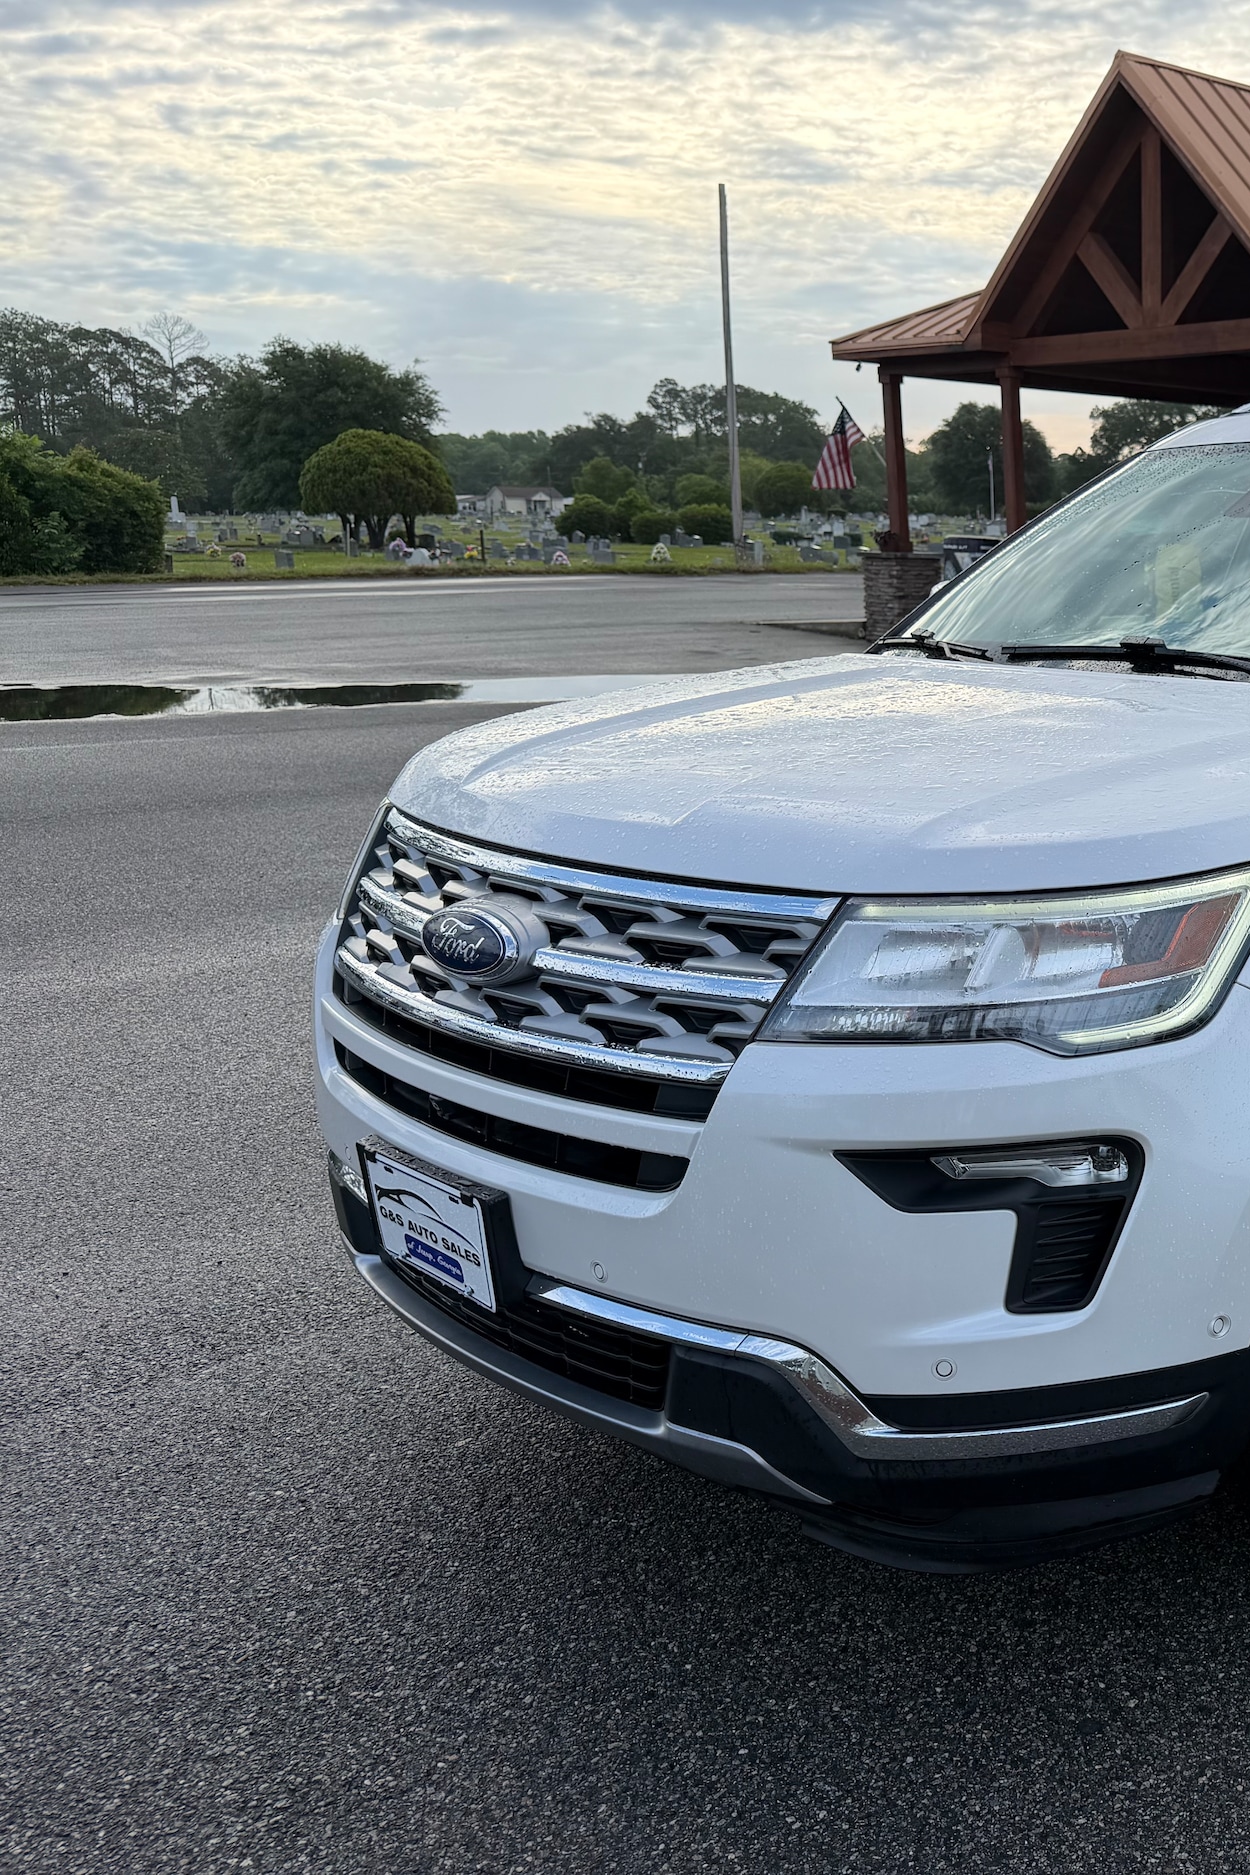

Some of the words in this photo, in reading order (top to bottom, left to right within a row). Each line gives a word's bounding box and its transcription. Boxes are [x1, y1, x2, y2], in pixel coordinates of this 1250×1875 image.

[432, 917, 485, 963] Ford
[379, 1205, 405, 1227] G&S
[408, 1220, 438, 1244] AUTO
[441, 1236, 481, 1267] SALES
